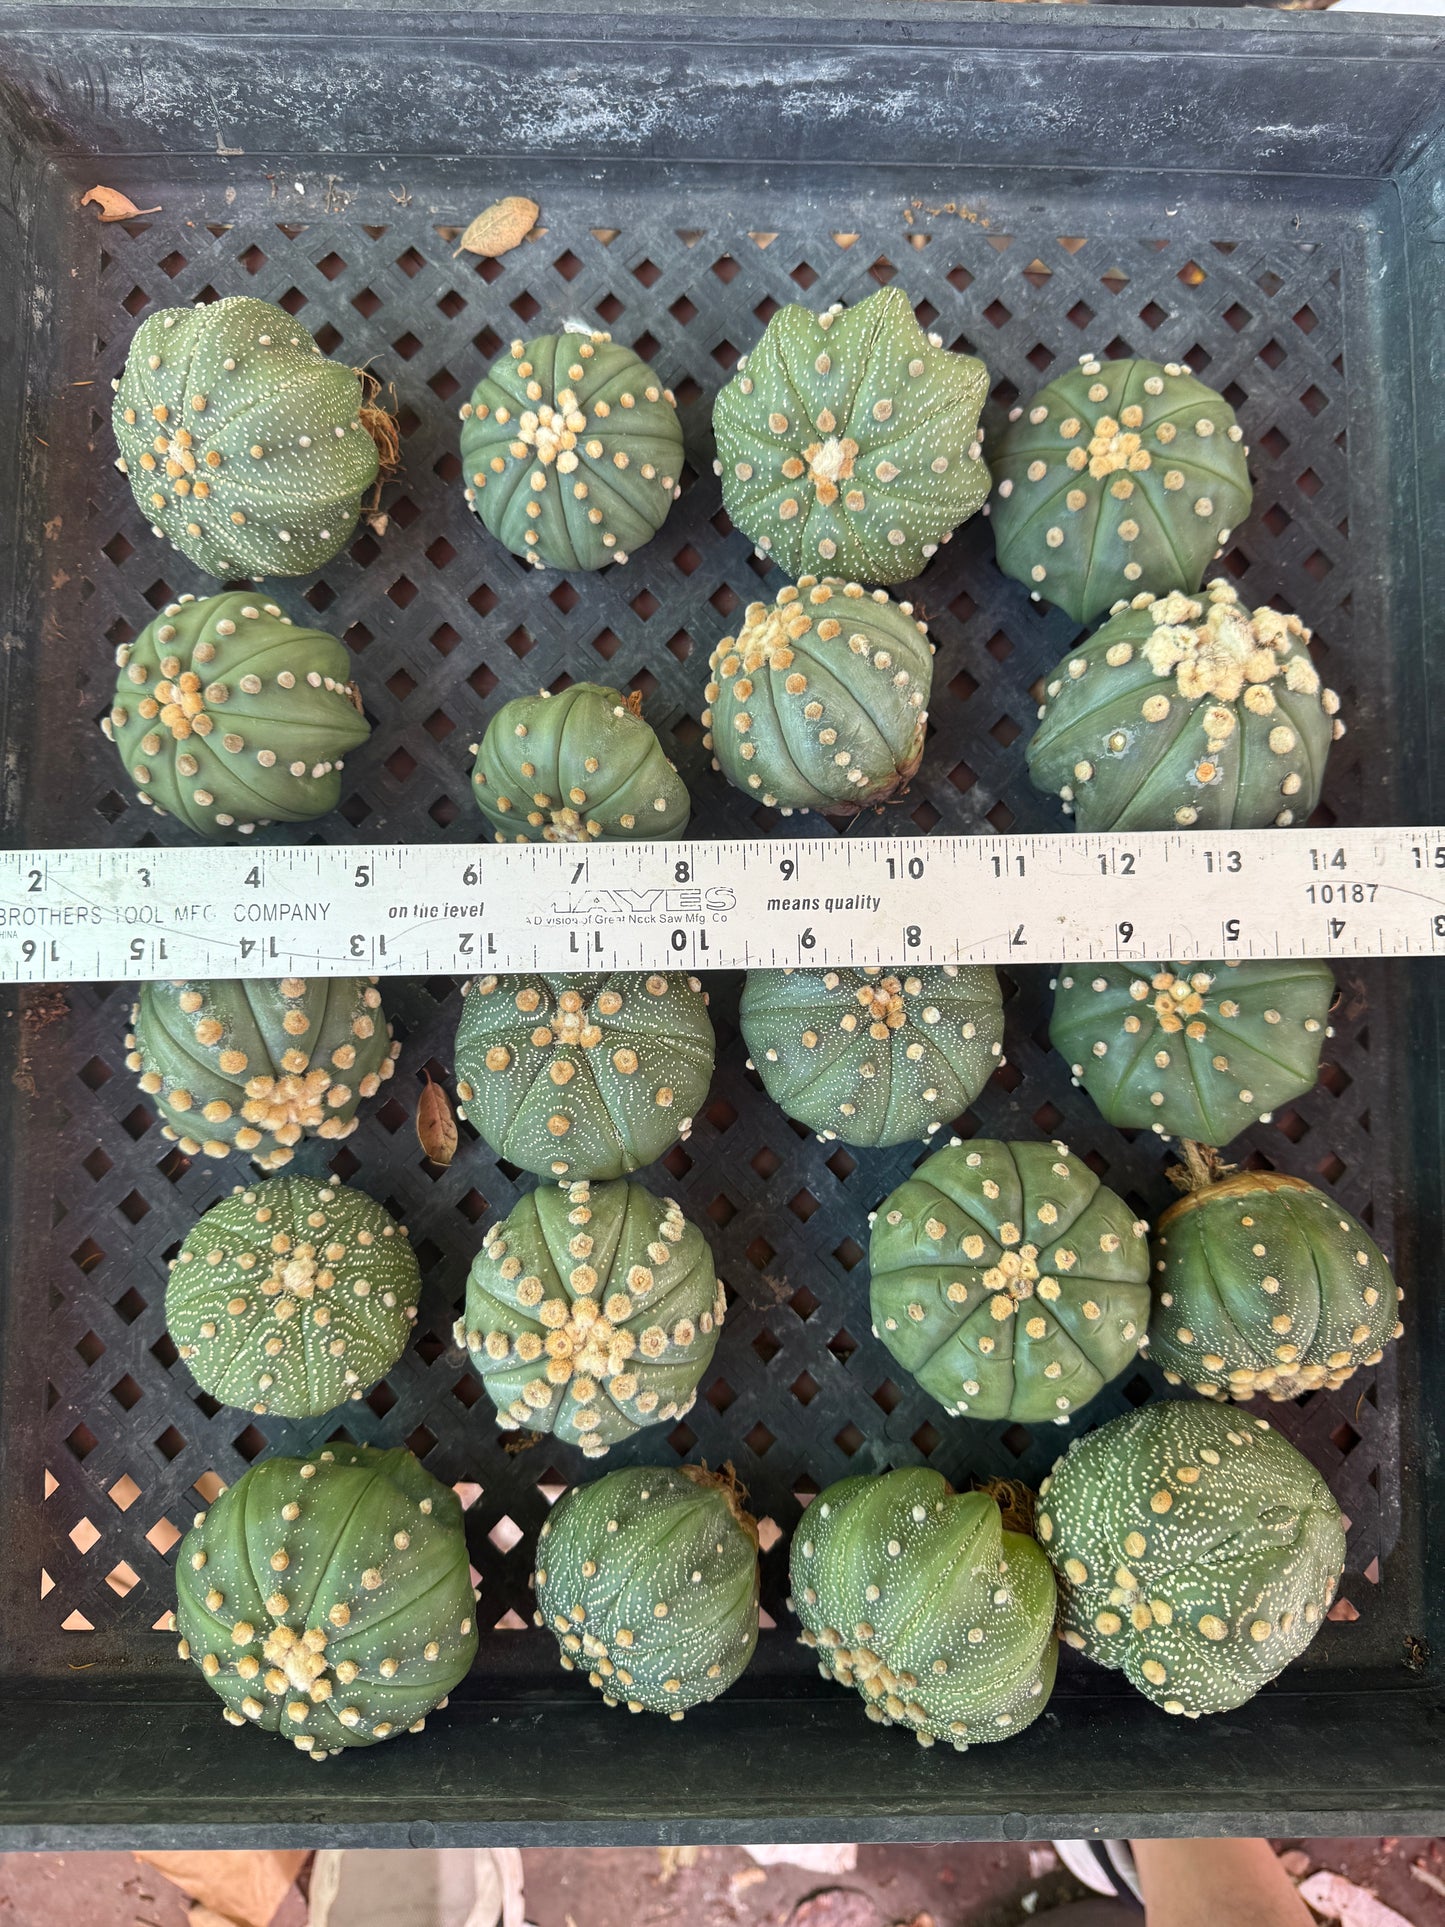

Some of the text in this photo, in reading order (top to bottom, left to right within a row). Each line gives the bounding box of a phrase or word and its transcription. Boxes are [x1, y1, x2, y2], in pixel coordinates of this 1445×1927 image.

[27, 846, 1445, 892] 2 3 4 5 6 7 8 9 10 11 12 13 14 15
[767, 894, 881, 914] means quality
[1305, 883, 1379, 904] 10187
[0, 906, 102, 926] BROTHERS
[114, 905, 164, 924] TOOL
[233, 902, 331, 922] COMPANY
[388, 906, 408, 919] on
[659, 913, 682, 924] Saw
[800, 927, 816, 949] 9
[905, 925, 922, 947] 8
[1011, 923, 1028, 945] 7
[1118, 921, 1134, 943] 6
[1225, 919, 1241, 942] 5
[1330, 917, 1347, 939] 4
[21, 939, 61, 962] 16
[130, 937, 169, 960] 15
[239, 936, 280, 959] 14
[349, 934, 387, 957] 13
[458, 932, 498, 955] 12
[569, 931, 605, 953] 11
[671, 929, 710, 951] 10
